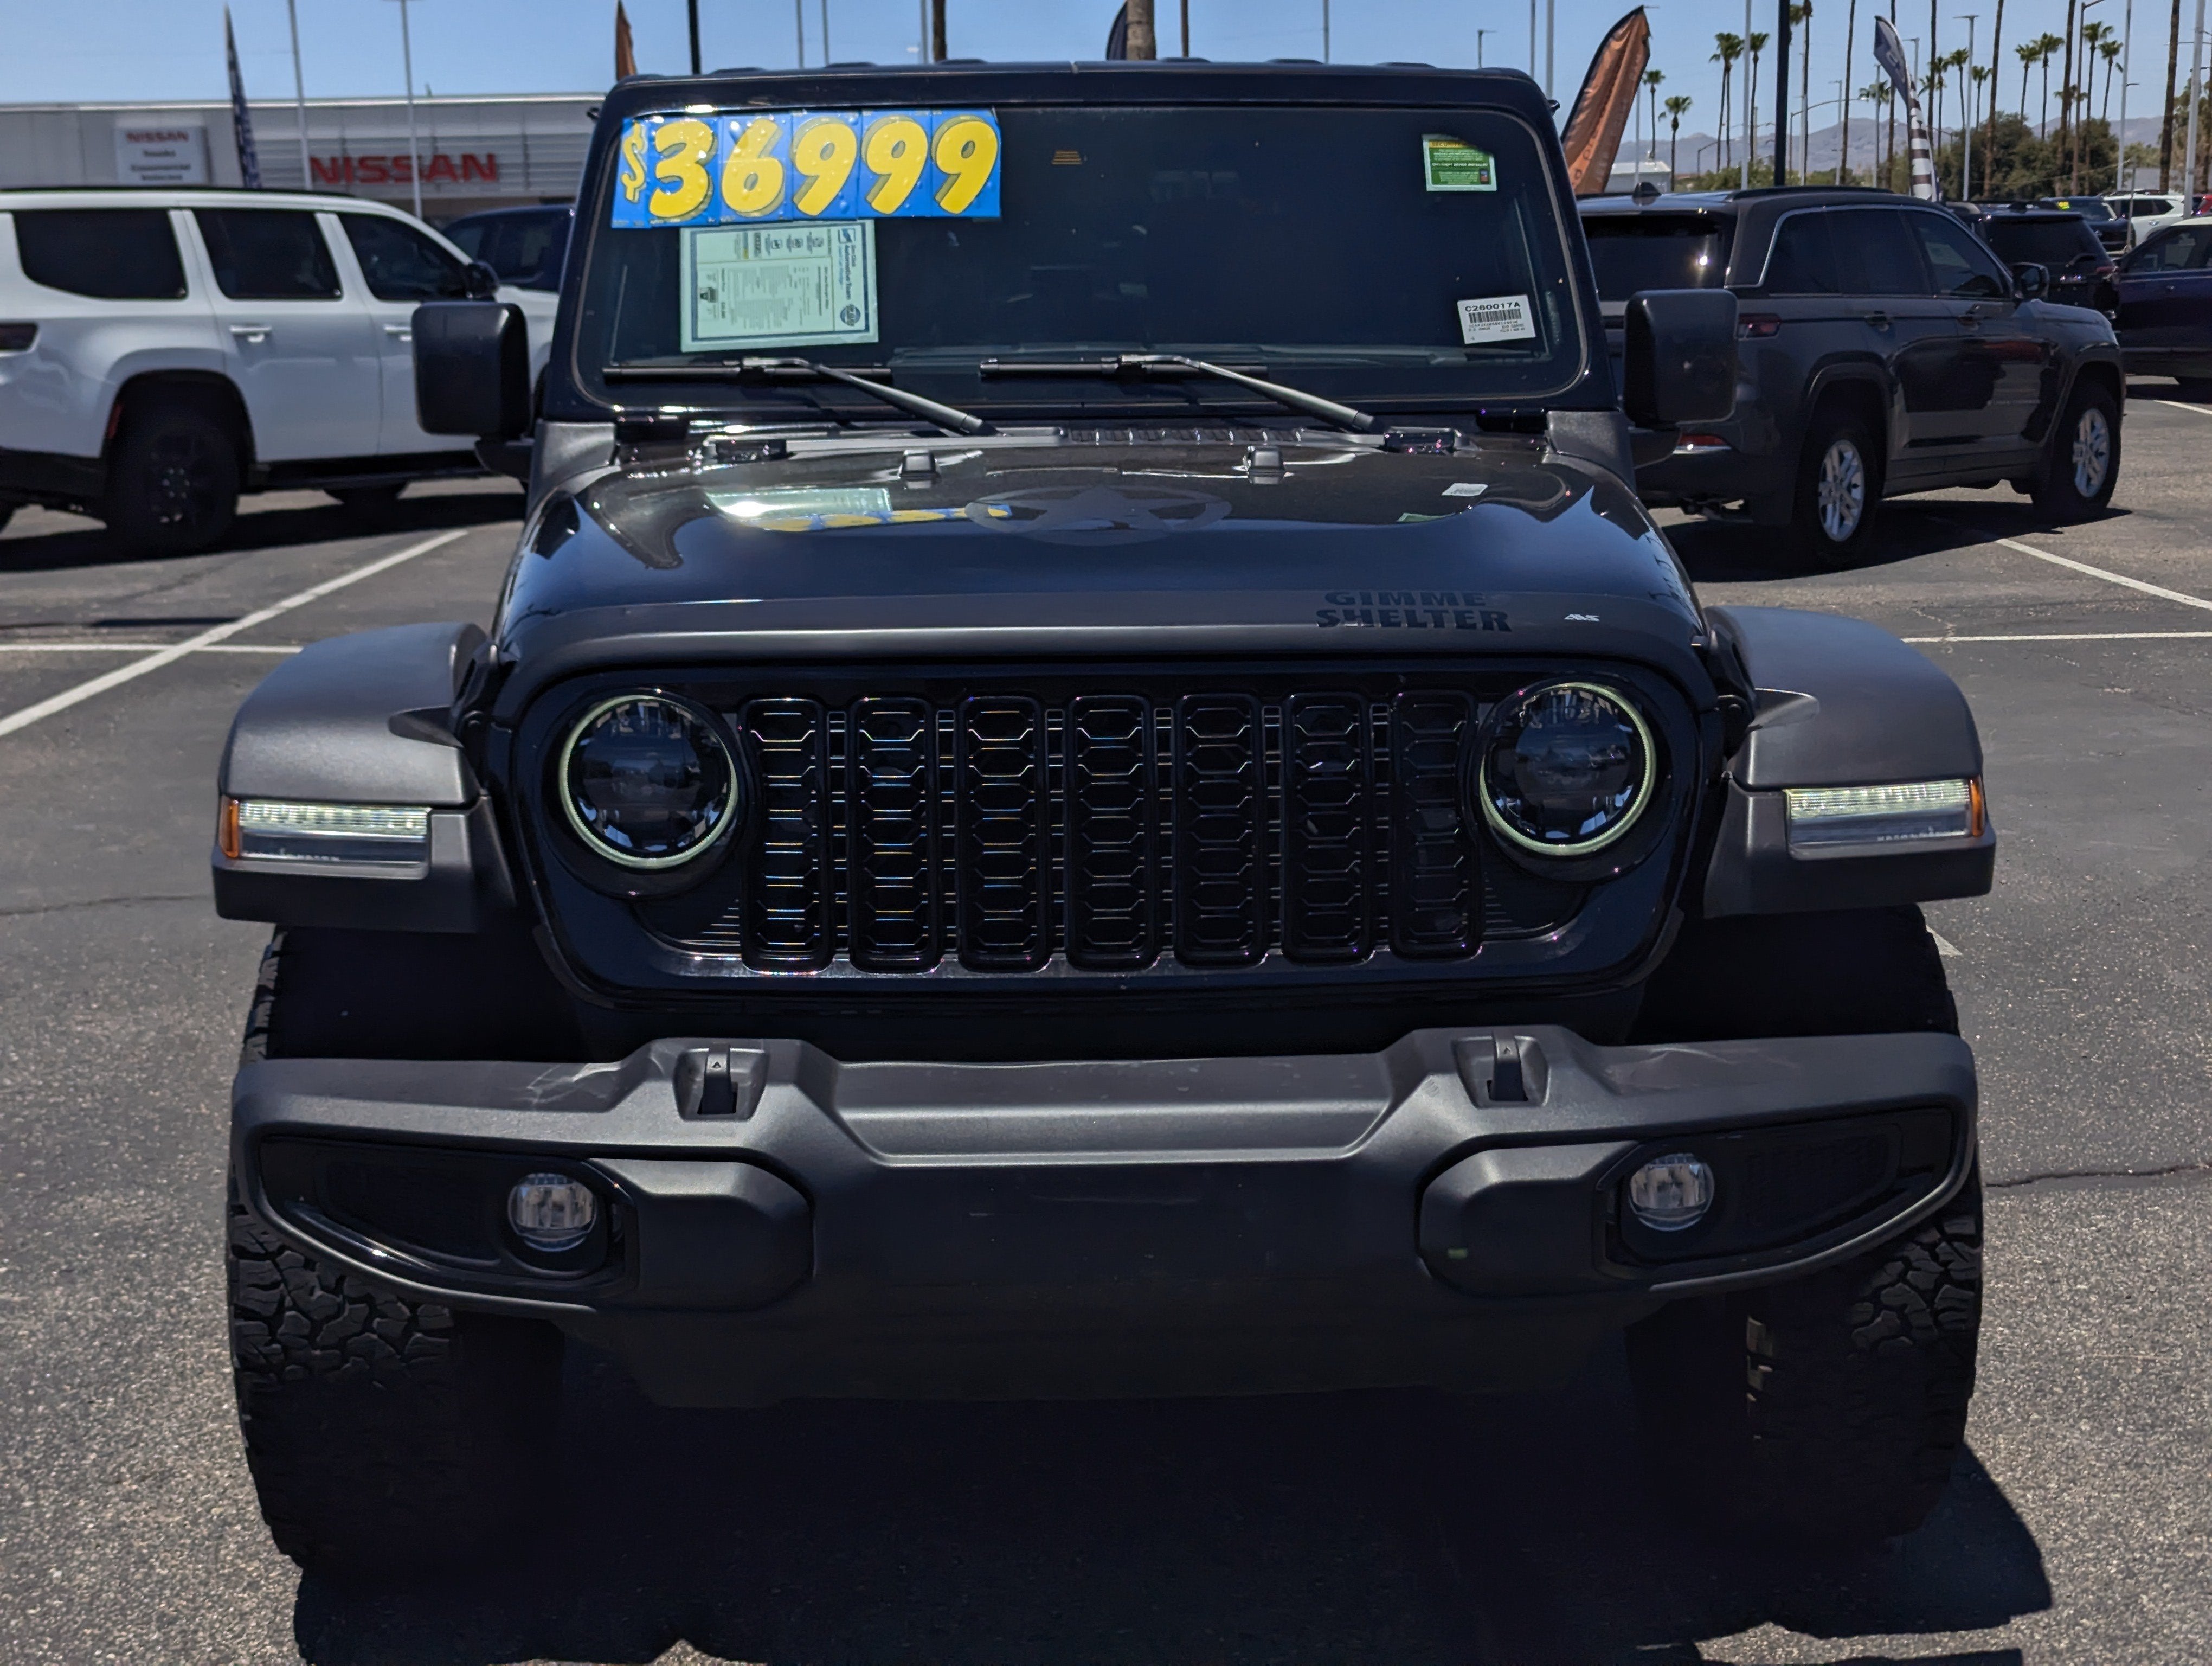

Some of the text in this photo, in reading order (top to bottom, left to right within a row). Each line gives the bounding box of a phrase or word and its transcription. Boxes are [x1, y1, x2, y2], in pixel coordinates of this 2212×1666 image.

[126, 131, 189, 142] NISSAN
[309, 153, 497, 185] NISSAN
[621, 115, 998, 220] $36999
[1465, 302, 1520, 312] C260017A
[1324, 591, 1486, 606] GIMME
[1316, 608, 1513, 632] SHELTER
